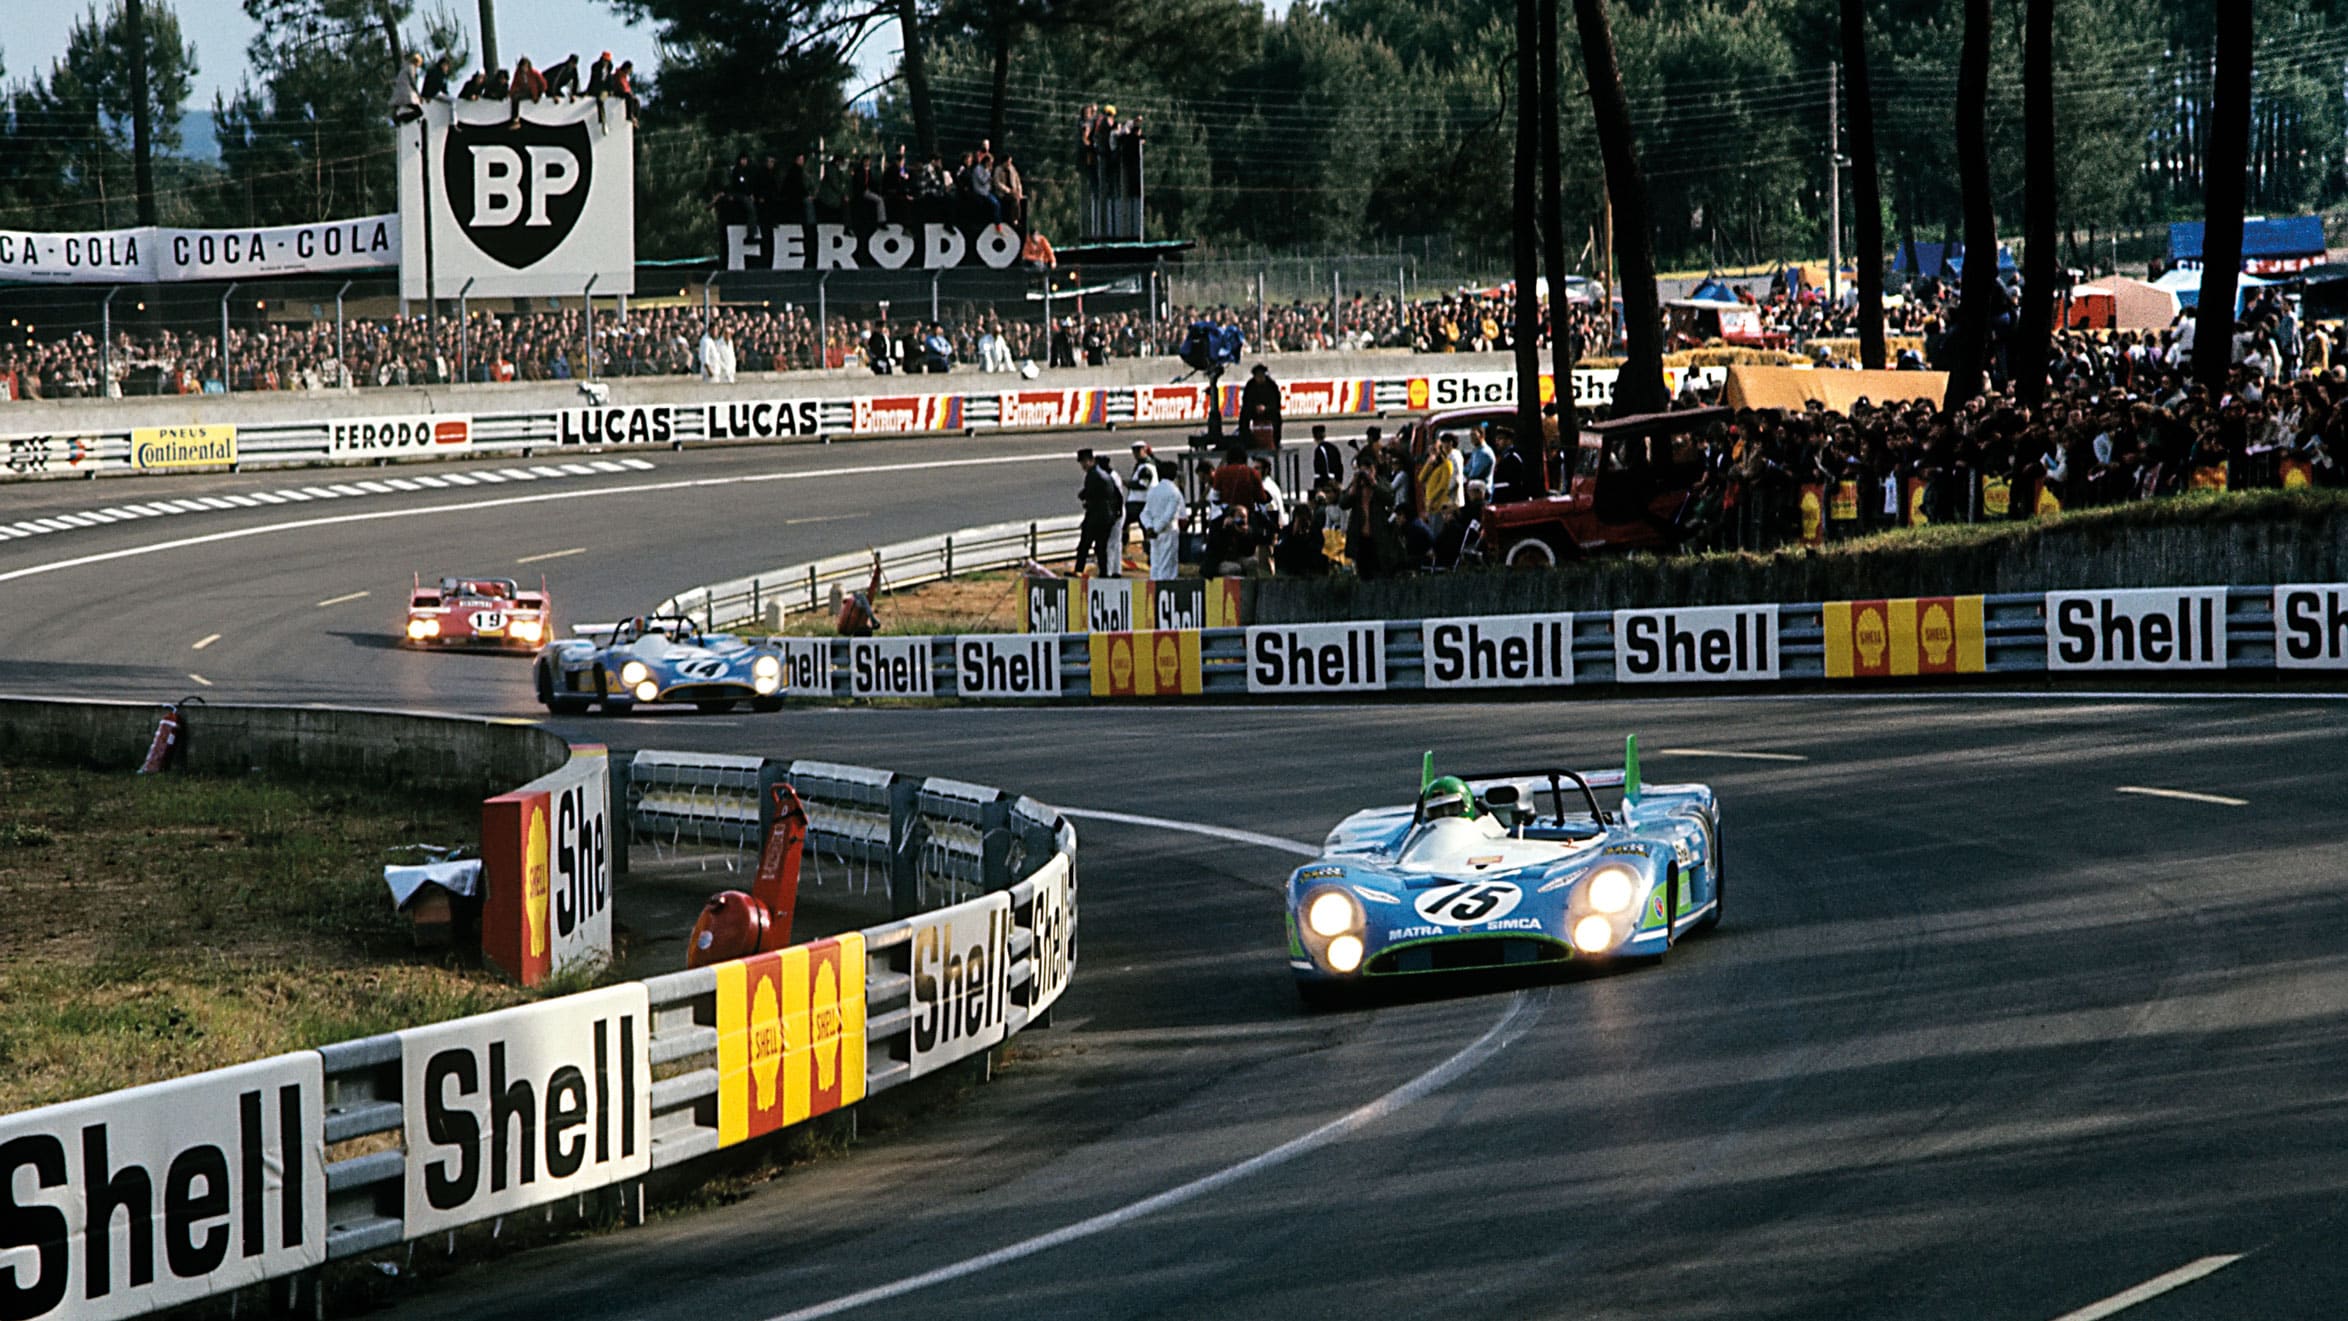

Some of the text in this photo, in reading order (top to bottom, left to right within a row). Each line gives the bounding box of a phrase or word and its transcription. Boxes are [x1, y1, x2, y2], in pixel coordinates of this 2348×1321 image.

[468, 145, 580, 227] BP
[726, 223, 1021, 270] FERODO
[1436, 377, 1514, 404] Shel
[160, 427, 207, 438] PNEUS
[335, 421, 430, 450] FERODO
[562, 407, 672, 445] LUCAS
[708, 401, 818, 439] LUCAS
[138, 437, 231, 468] Continental
[476, 613, 500, 628] 19
[1860, 630, 1881, 645] SHELL
[1926, 627, 1948, 641] SHELL
[2058, 597, 2213, 663] Shell
[1255, 629, 1376, 686] Shell
[1433, 621, 1562, 681] Shell
[1626, 613, 1768, 674] Shell
[684, 661, 722, 677] 14
[773, 642, 827, 689] hell
[855, 643, 928, 693] Shell
[962, 640, 1053, 693] Shell
[1424, 884, 1517, 921] 15
[1030, 870, 1068, 1008] Shell
[1388, 917, 1543, 941] MATRA SIMCA
[914, 907, 1008, 1053] Shell
[755, 1026, 778, 1059] SHELL
[816, 1007, 836, 1041] SHELL
[424, 1015, 635, 1211] Shell
[0, 1083, 303, 1320] Shell
